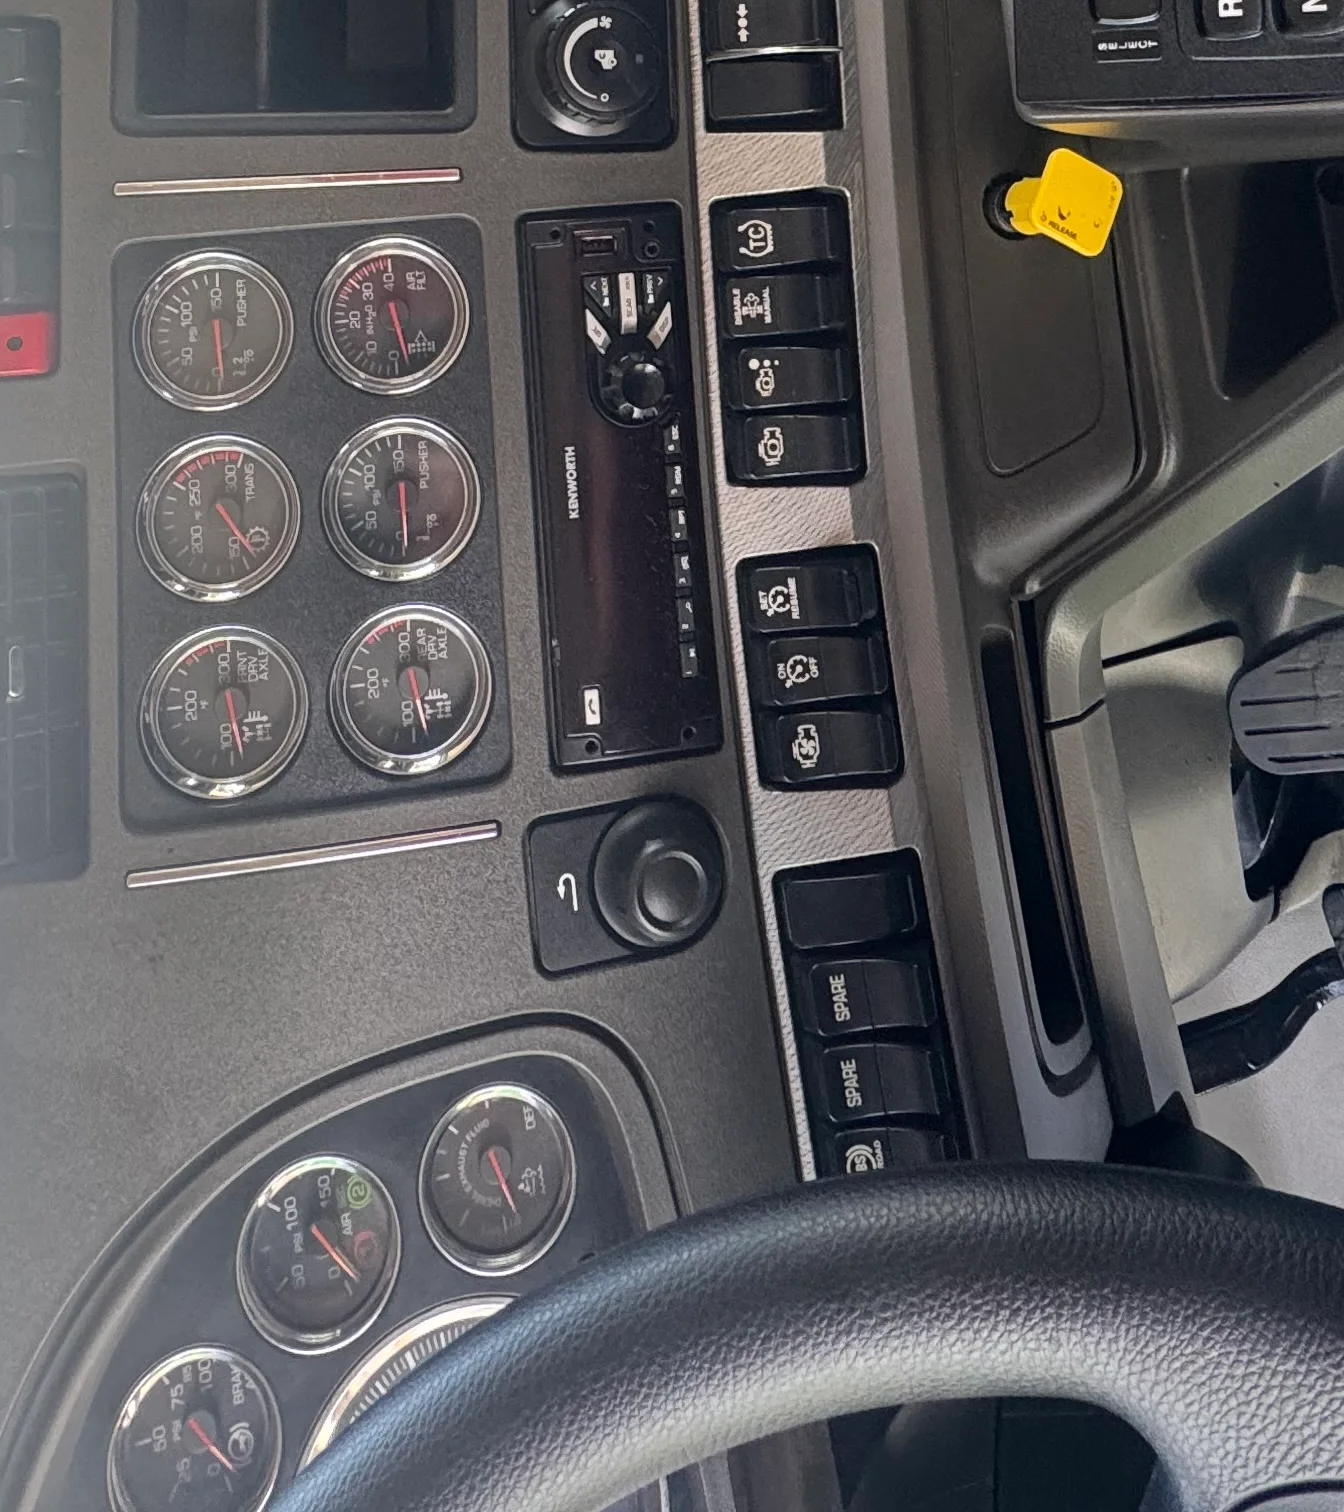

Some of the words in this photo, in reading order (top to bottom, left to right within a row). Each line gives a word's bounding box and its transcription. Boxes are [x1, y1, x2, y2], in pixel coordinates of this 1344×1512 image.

[1098, 40, 1158, 51] SELECT
[749, 227, 766, 250] TC
[362, 283, 373, 300] 30
[383, 273, 394, 291] 40
[406, 272, 416, 290] AIR
[416, 271, 426, 290] FILT
[181, 302, 192, 327] 100
[237, 279, 246, 326] PUSHER
[350, 311, 360, 328] 20
[189, 326, 198, 342] PSI
[181, 348, 192, 366] 50
[366, 341, 377, 355] 10
[389, 351, 399, 360] 0
[393, 450, 404, 474] 150
[419, 441, 429, 488] PUSHER
[225, 465, 237, 492] 300
[245, 463, 255, 502] TRANS
[364, 465, 375, 491] 100
[564, 446, 579, 519] KENWORTH
[189, 480, 201, 506] 250
[366, 511, 377, 529] 50
[191, 526, 203, 554] 200
[759, 591, 768, 610] SET
[399, 633, 410, 661] 300
[428, 635, 437, 660] DRV
[437, 627, 447, 658] AXLE
[218, 653, 230, 683] 300
[248, 656, 257, 682] DRV
[259, 649, 268, 680] AXLE
[777, 663, 786, 679] ON
[808, 657, 818, 678] OFF
[367, 668, 379, 699] 200
[185, 690, 197, 721] 200
[402, 701, 413, 727] 100
[220, 723, 232, 749] 100
[829, 974, 850, 1021] SPARE
[841, 1059, 862, 1107] SPARE
[318, 1175, 331, 1207] 150
[284, 1196, 298, 1230] 100
[341, 1212, 353, 1235] AIR
[294, 1232, 303, 1253] PSI
[171, 1384, 185, 1410] 75
[153, 1425, 167, 1452] 50
